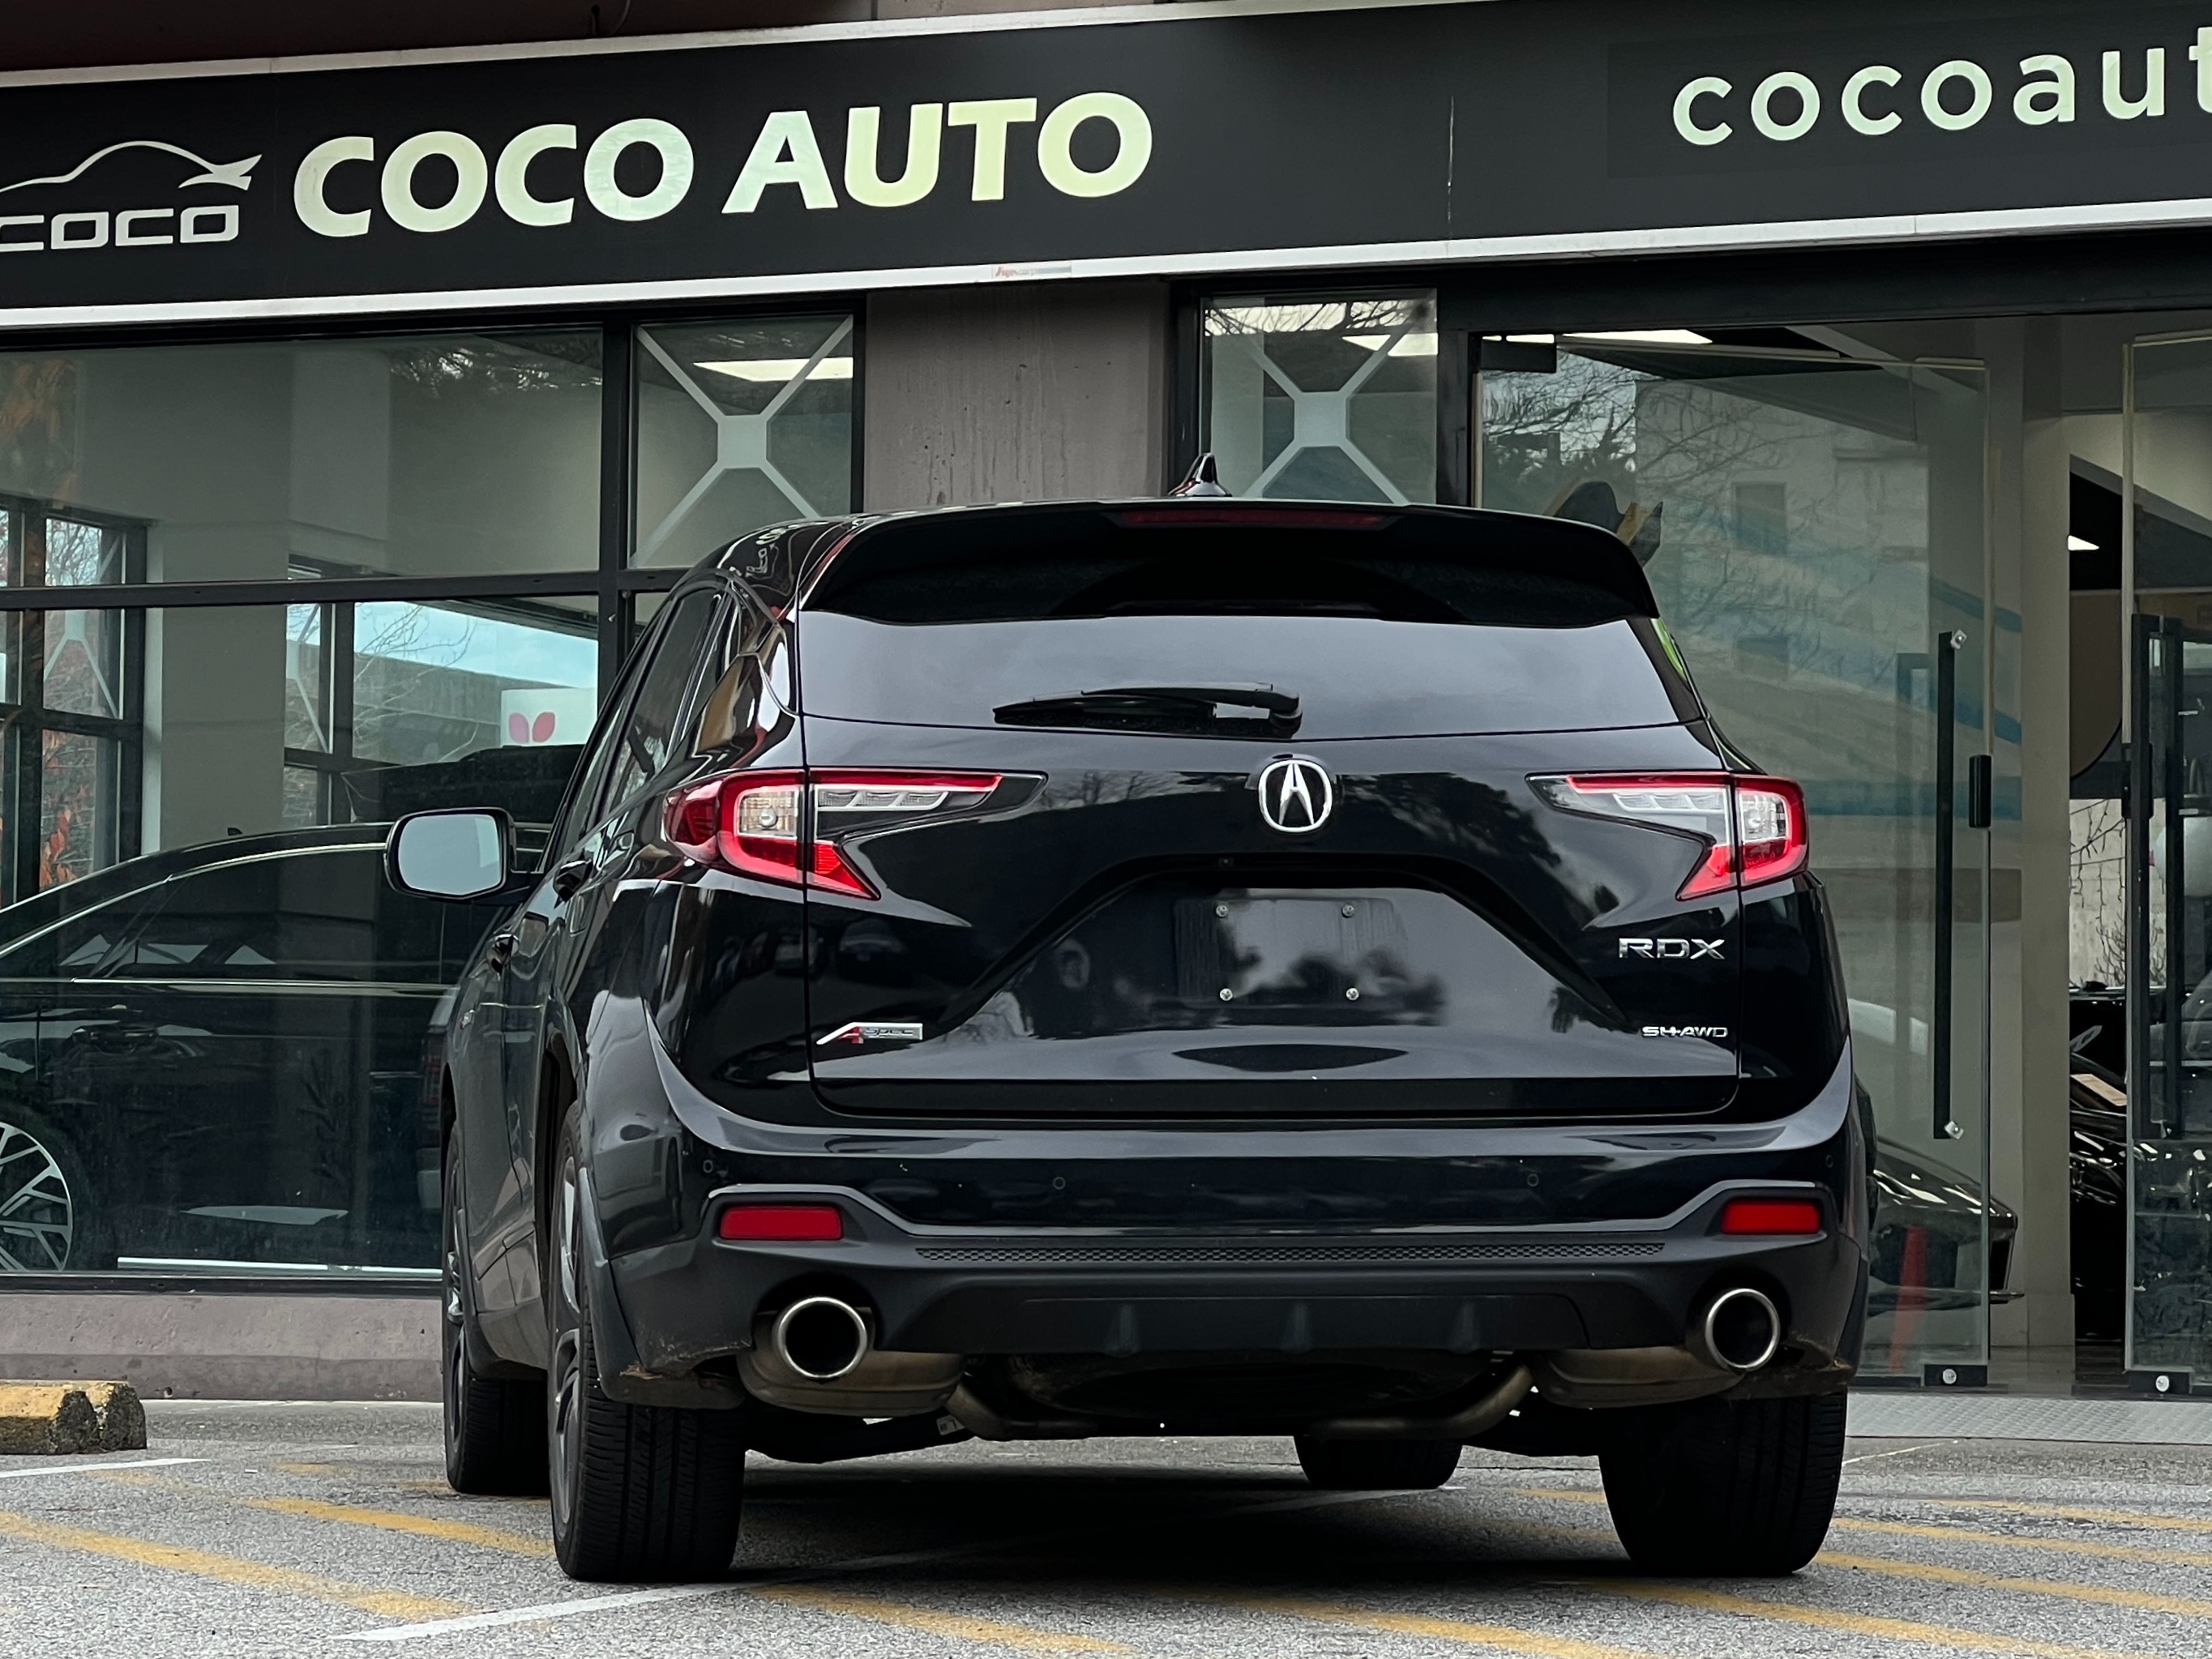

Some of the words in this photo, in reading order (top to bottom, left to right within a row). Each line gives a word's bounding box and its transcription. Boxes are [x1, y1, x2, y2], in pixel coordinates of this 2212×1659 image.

[293, 118, 695, 237] COCO
[721, 92, 1153, 213] AUTO
[0, 204, 239, 252] COCO
[1619, 938, 1726, 960] RDX
[1641, 1026, 1729, 1037] SH-AWD
